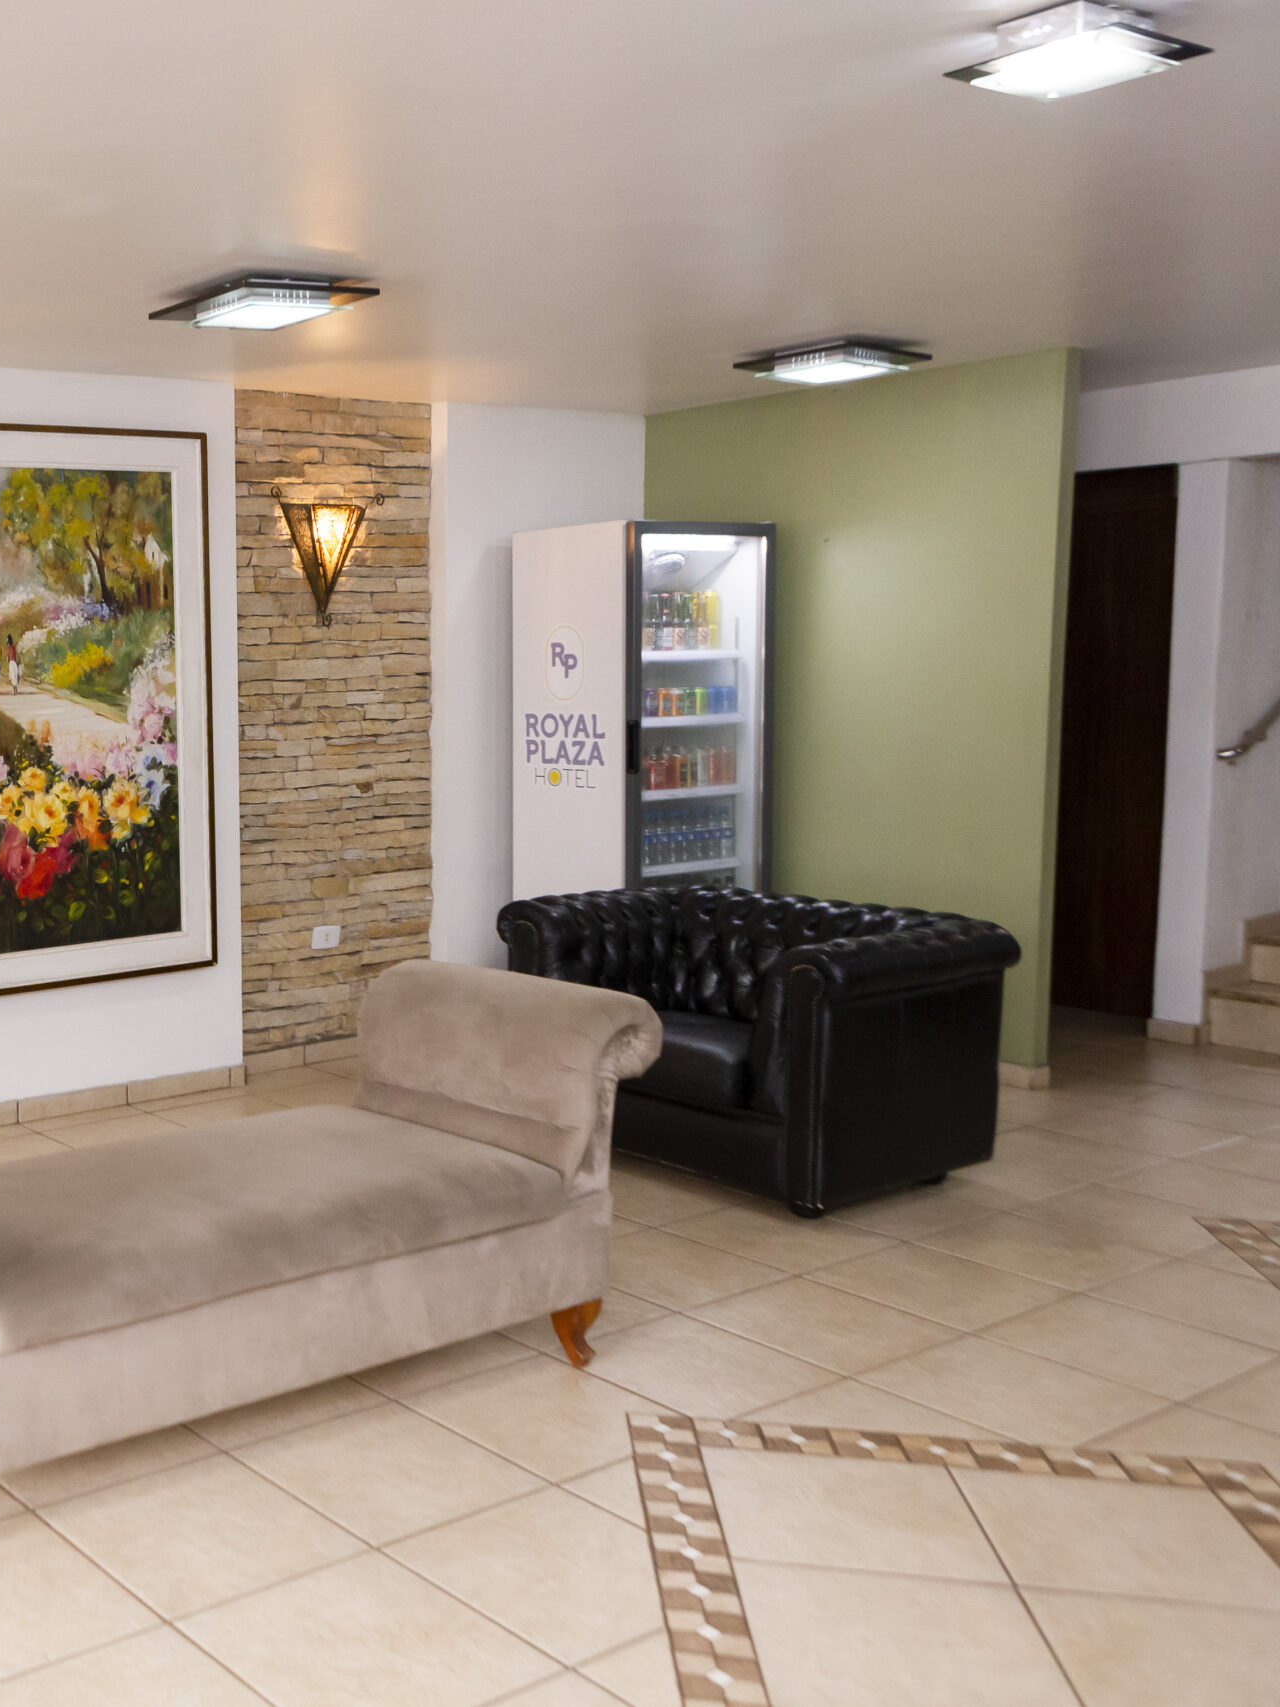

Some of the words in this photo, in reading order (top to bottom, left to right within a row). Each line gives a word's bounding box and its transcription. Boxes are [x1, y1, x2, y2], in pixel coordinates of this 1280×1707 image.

[525, 712, 606, 739] ROYAL
[525, 739, 605, 767] PLAZA
[534, 767, 596, 789] HOTEL
